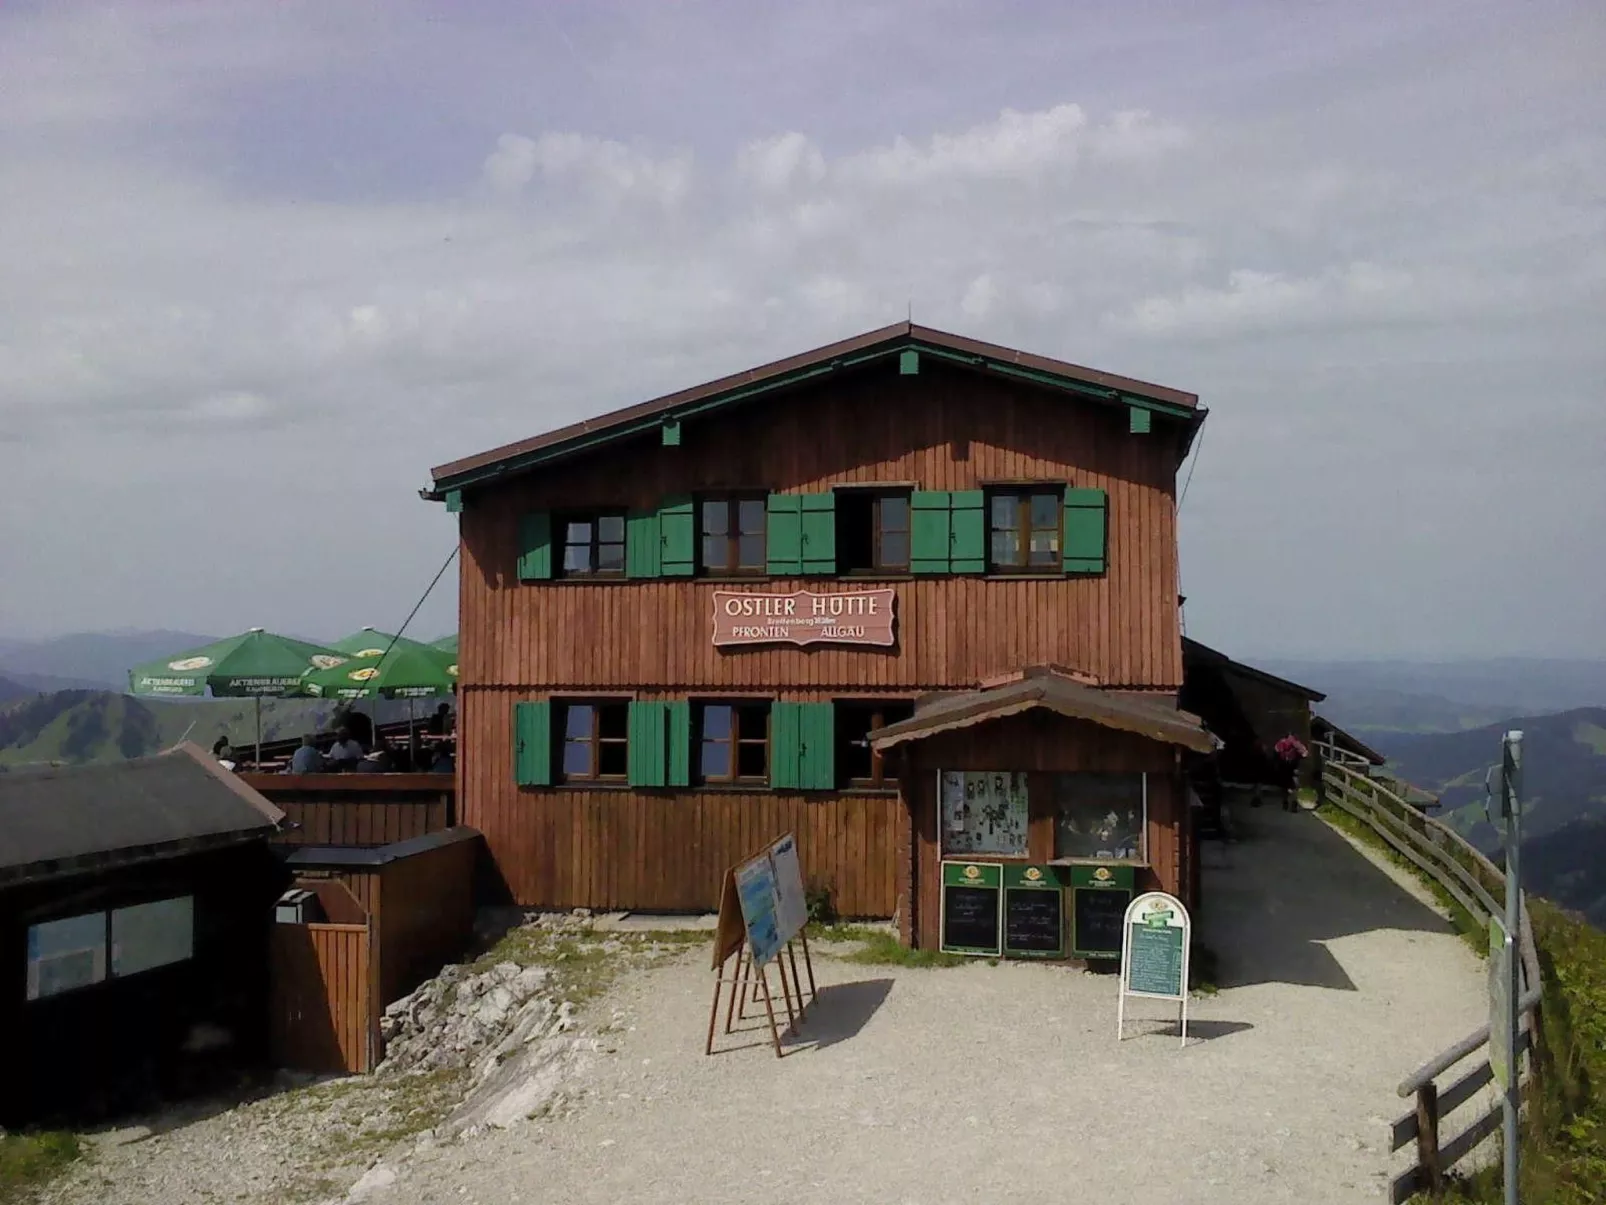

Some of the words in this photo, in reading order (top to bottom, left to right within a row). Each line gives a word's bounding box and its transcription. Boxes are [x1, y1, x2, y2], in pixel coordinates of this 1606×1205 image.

[725, 598, 795, 616] OSTLER
[812, 596, 878, 616] HÜTTE
[732, 626, 789, 638] PFRONTEN
[820, 625, 865, 638] ALLGÄU
